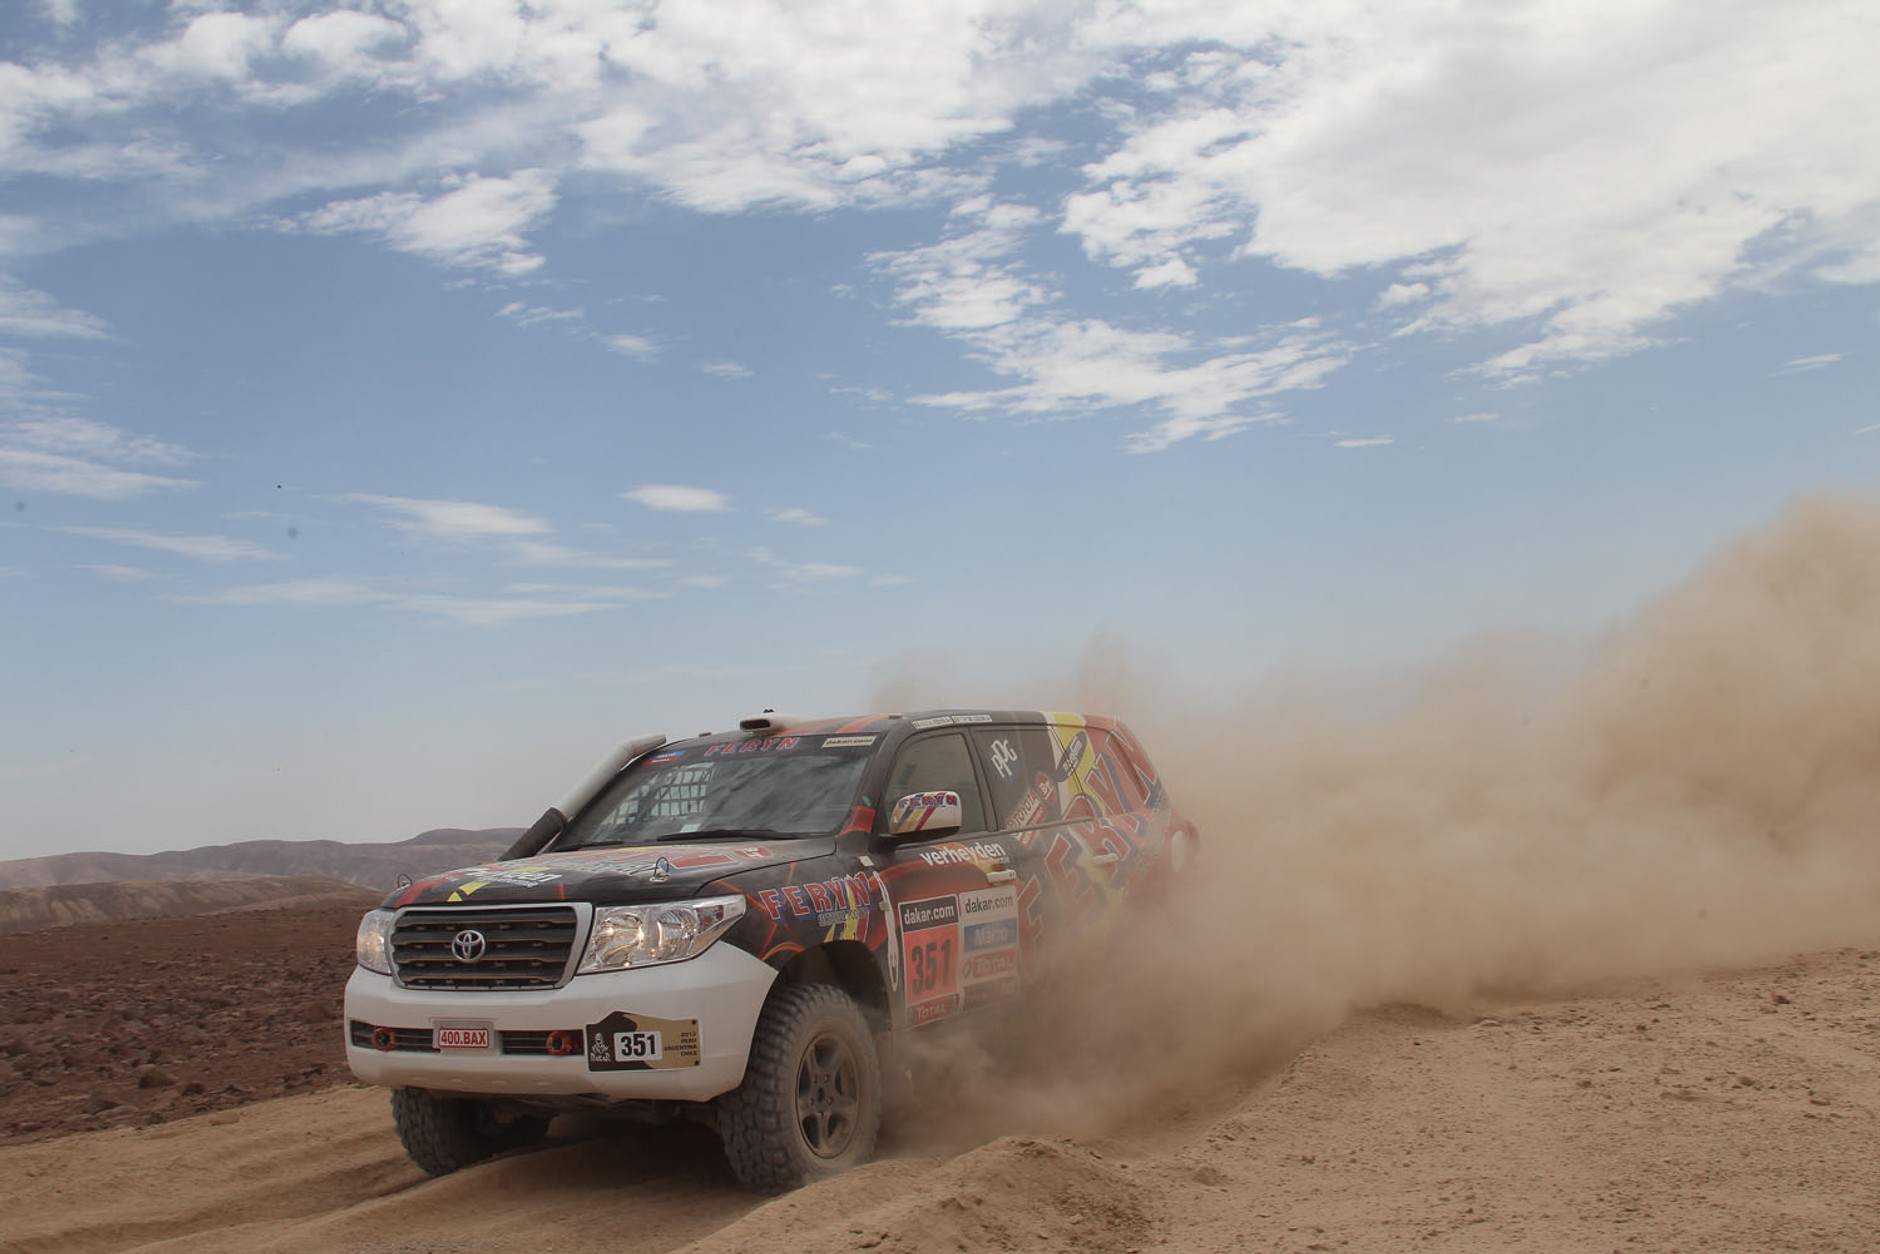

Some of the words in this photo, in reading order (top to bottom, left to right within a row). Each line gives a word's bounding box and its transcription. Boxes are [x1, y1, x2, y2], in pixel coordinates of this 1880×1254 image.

[703, 737, 800, 757] FERYN
[898, 791, 958, 808] FERYN
[920, 842, 1006, 867] verheyden
[758, 871, 872, 921] FERYN
[964, 896, 1013, 914] dakar.com
[904, 905, 955, 925] dakar.com
[911, 938, 951, 996] 351
[441, 1031, 486, 1045] 400.BAX
[620, 1033, 656, 1057] 351
